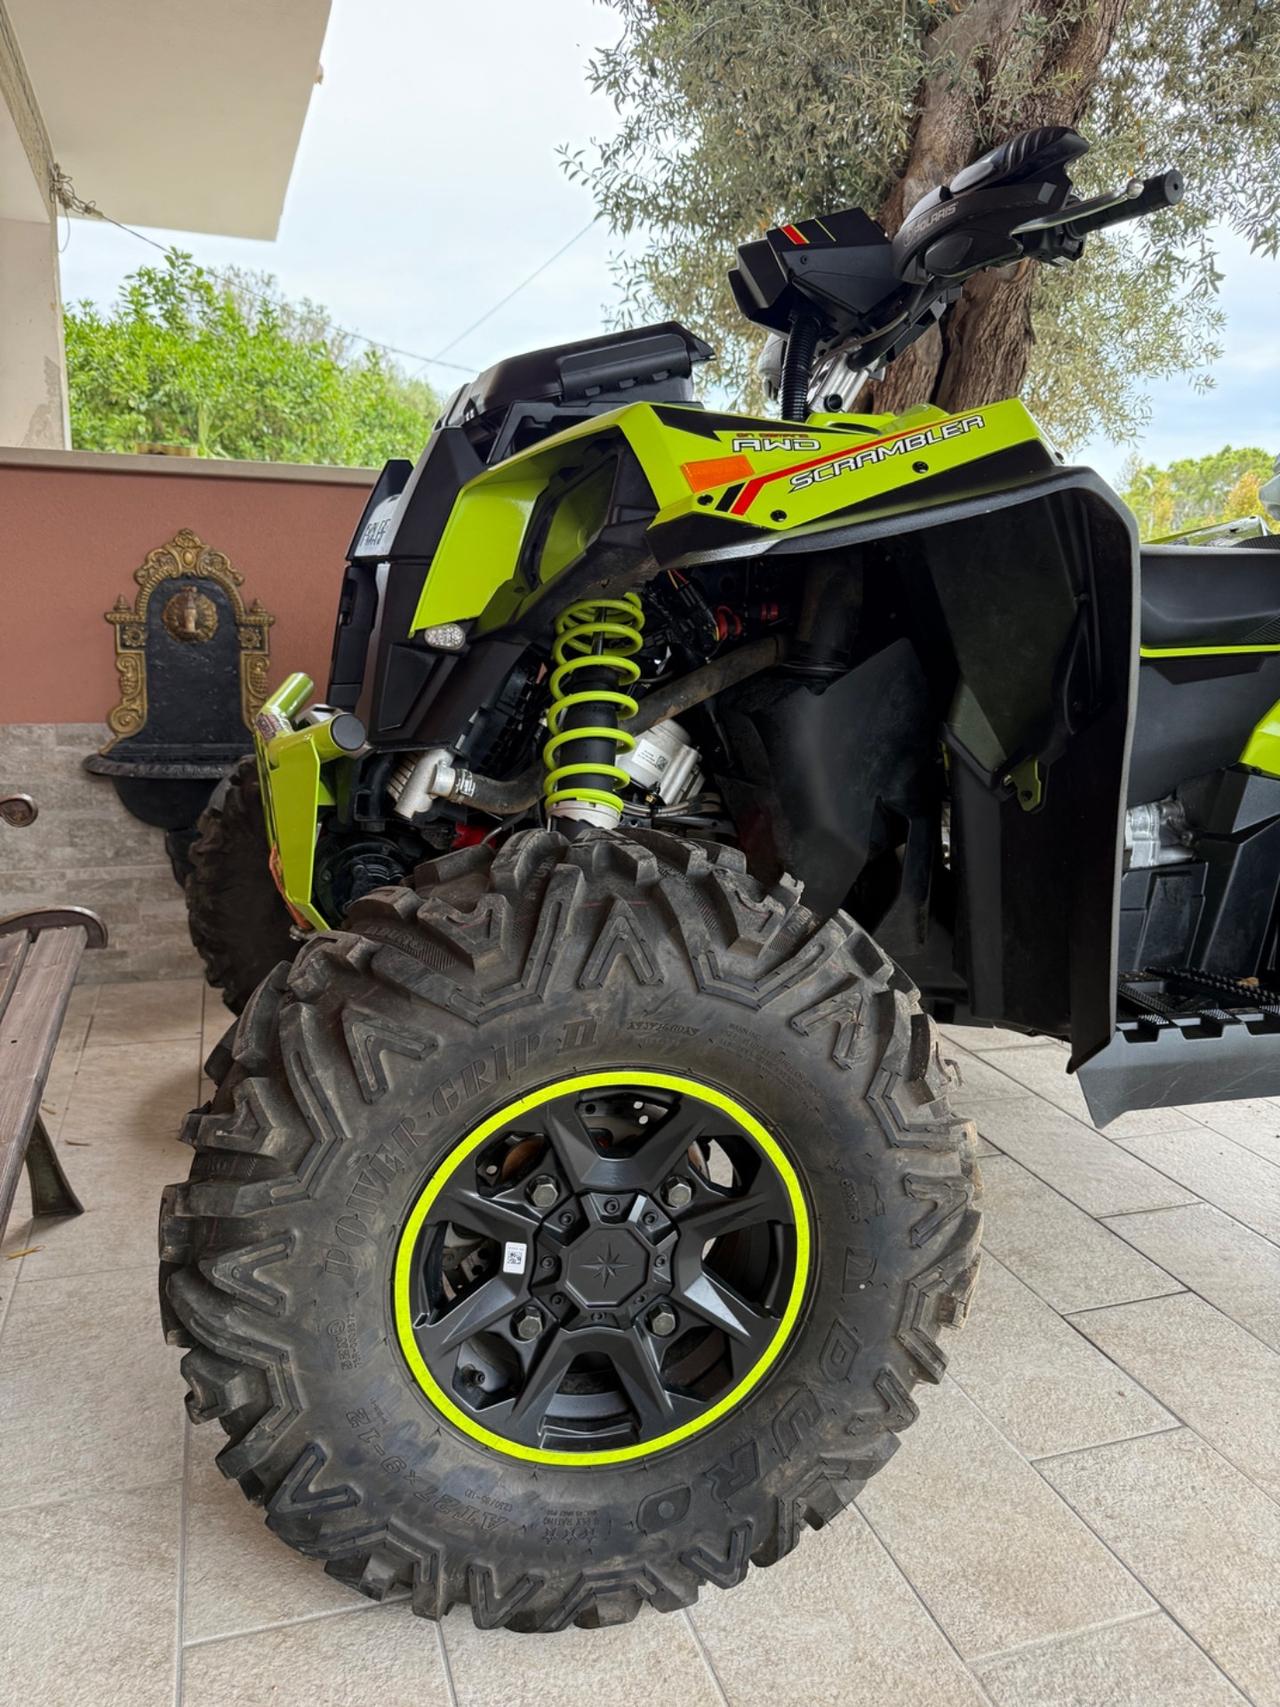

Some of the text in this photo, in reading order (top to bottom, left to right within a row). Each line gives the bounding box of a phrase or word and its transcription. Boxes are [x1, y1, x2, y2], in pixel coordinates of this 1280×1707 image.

[913, 201, 959, 232] POLARIS
[732, 438, 821, 452] AWD
[788, 414, 985, 494] SCRAMBLER
[636, 1318, 863, 1535] DURO
